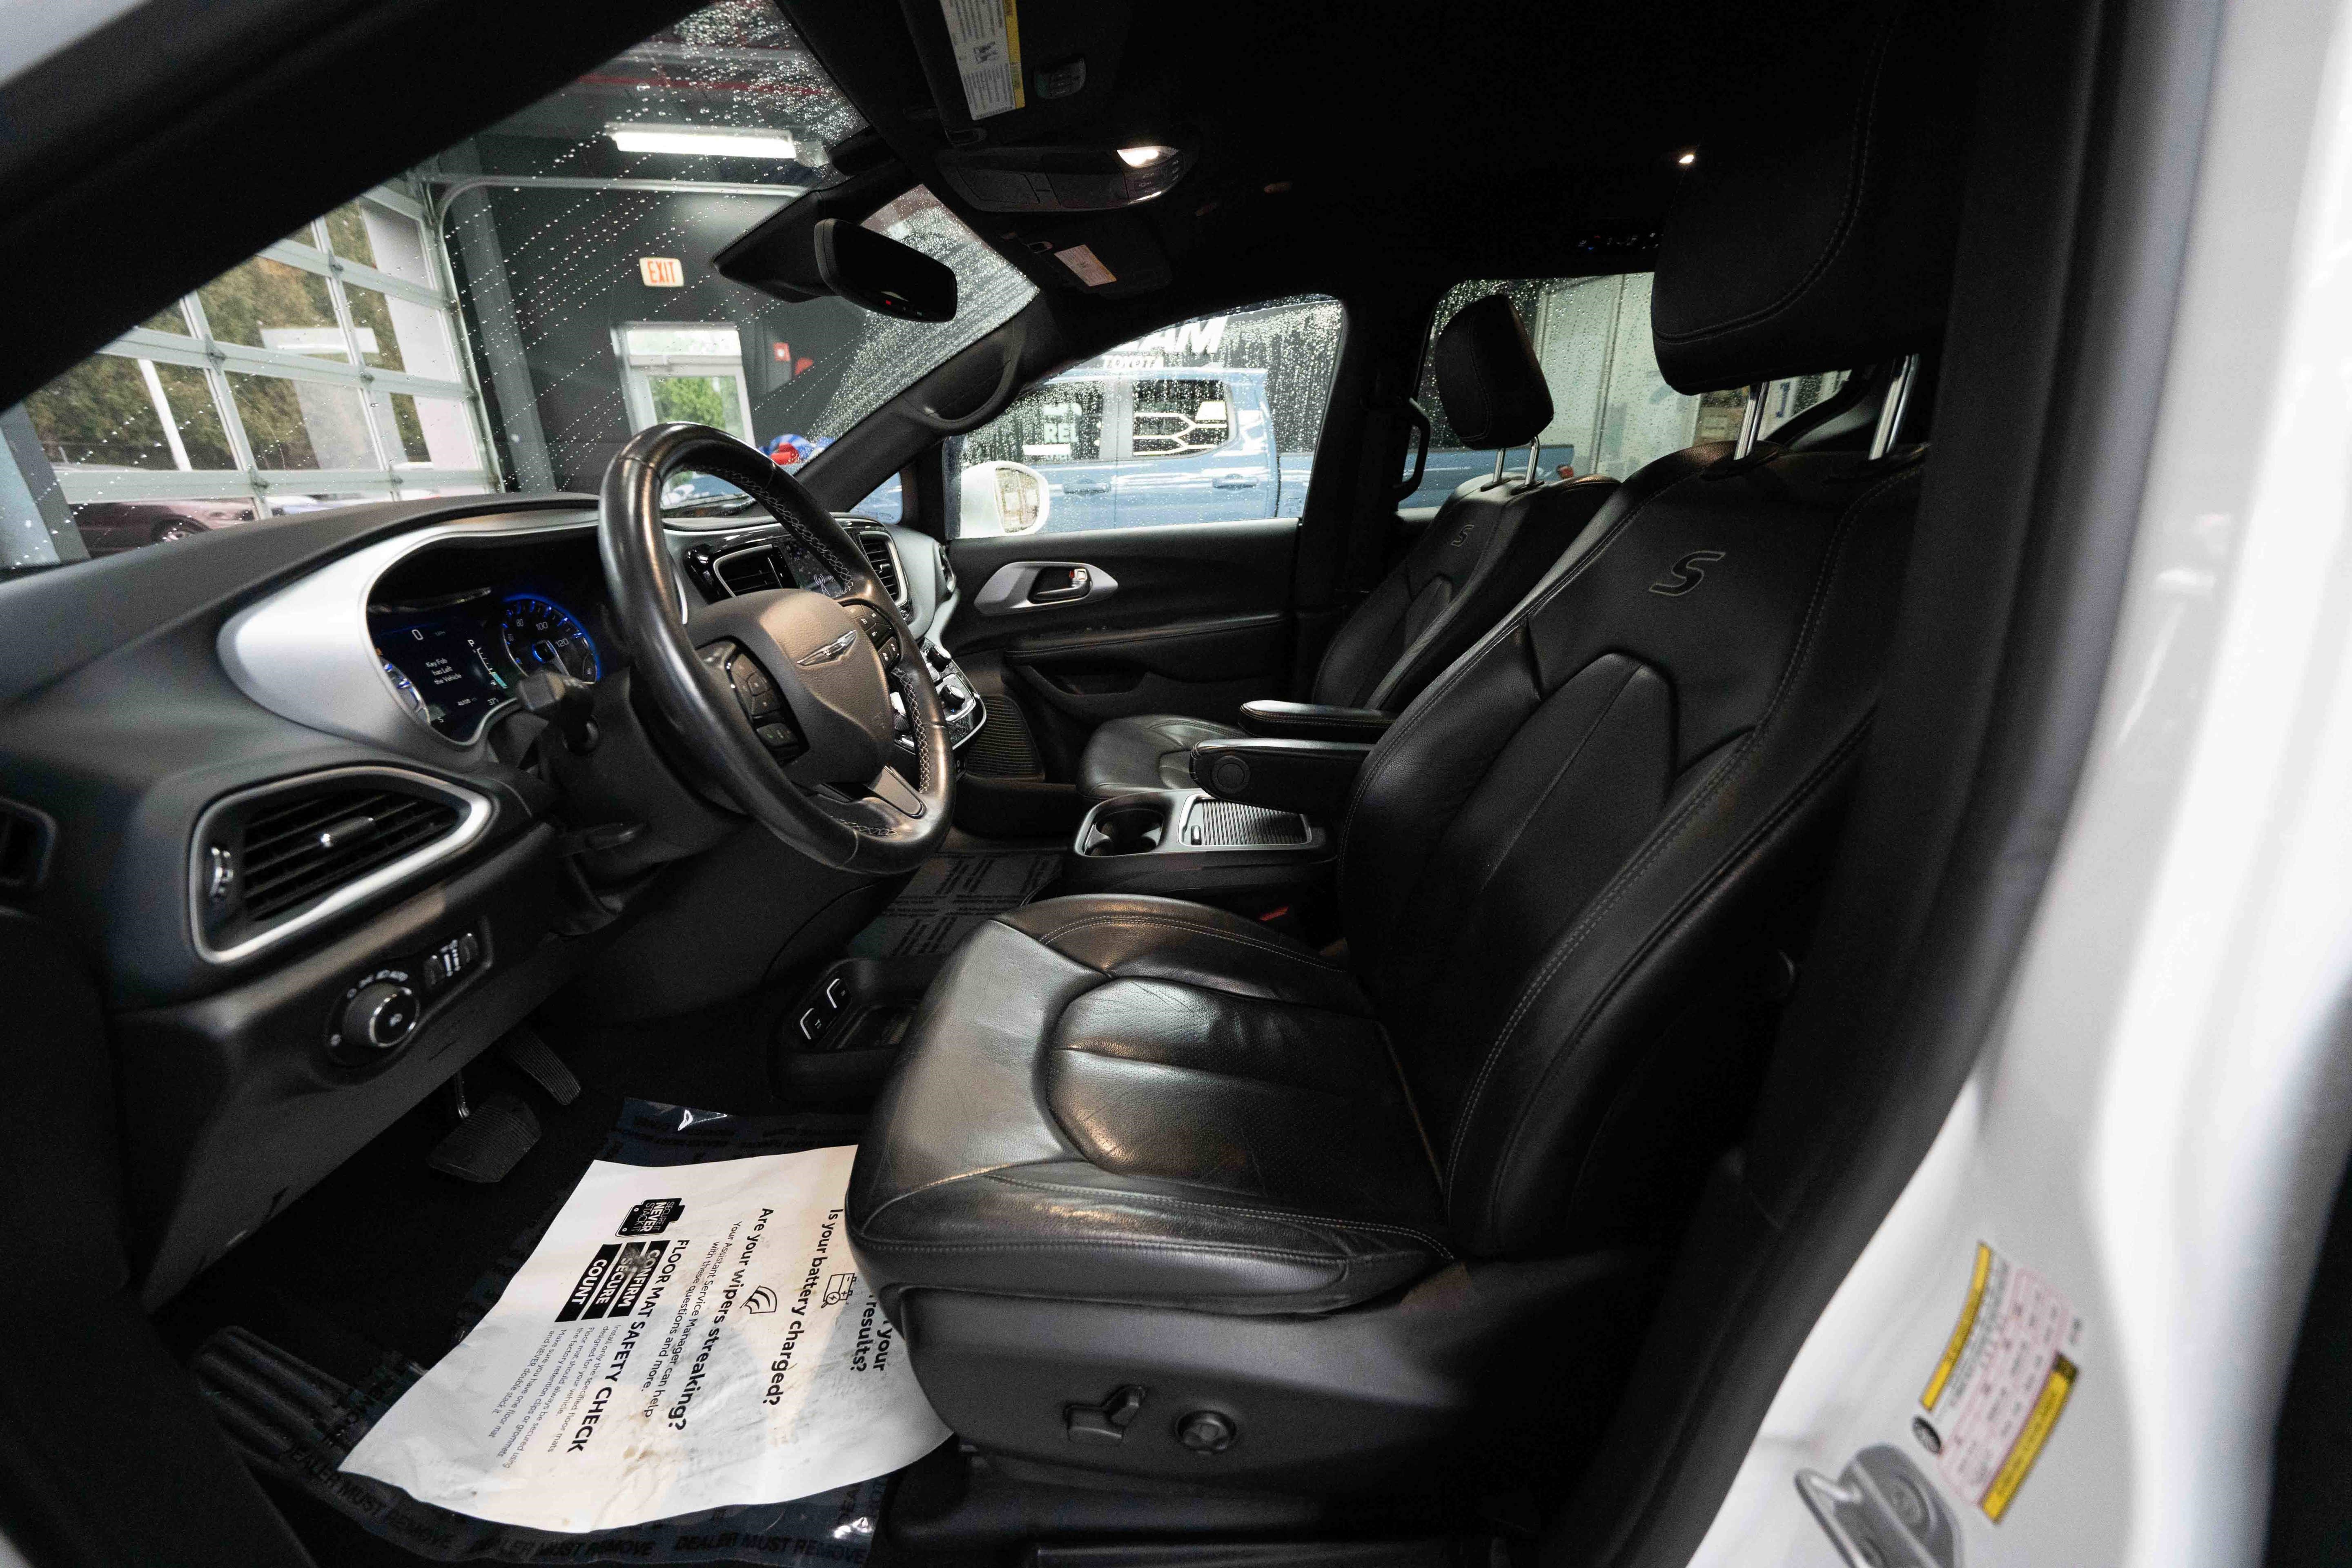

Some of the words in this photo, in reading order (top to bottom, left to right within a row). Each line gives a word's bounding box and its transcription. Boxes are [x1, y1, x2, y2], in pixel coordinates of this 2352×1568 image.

[647, 260, 677, 283] EXIT
[1649, 550, 1726, 597] S
[516, 619, 523, 627] 80
[536, 621, 548, 630] 100
[412, 629, 424, 640] 0
[555, 638, 569, 647] 120
[442, 673, 462, 682] Vehicle
[637, 1203, 655, 1224] STACK
[640, 1202, 666, 1231] NEVER
[653, 1202, 674, 1225] SECURE
[754, 1208, 774, 1231] Are
[829, 1209, 843, 1220] Is
[728, 1221, 742, 1240] Your
[816, 1223, 835, 1253] your
[706, 1242, 719, 1258] with
[739, 1234, 760, 1265] your
[655, 1240, 690, 1284] FLOOR
[707, 1243, 732, 1278] Assistant
[572, 1260, 607, 1304] COUNT
[596, 1258, 633, 1304] SECURE
[618, 1250, 660, 1307] CONFIRM
[693, 1261, 711, 1283] these
[714, 1270, 745, 1323] wipers
[791, 1257, 828, 1316] battery
[638, 1287, 664, 1317] MAT
[692, 1281, 713, 1316] Service
[670, 1285, 695, 1334] questions
[544, 1331, 554, 1343] and
[552, 1330, 567, 1347] Make
[573, 1328, 583, 1339] the
[581, 1327, 595, 1343] Floor
[588, 1326, 609, 1357] designed
[605, 1325, 621, 1344] Install
[670, 1319, 698, 1365] Manager
[850, 1301, 877, 1372] results?
[528, 1345, 547, 1366] NEVER
[542, 1349, 554, 1363] sure
[558, 1341, 577, 1364] factory
[572, 1346, 583, 1359] mat
[596, 1346, 607, 1361] only
[605, 1322, 645, 1382] SAFETY
[659, 1337, 673, 1356] and
[873, 1326, 893, 1371] your
[533, 1365, 544, 1376] you
[559, 1361, 575, 1383] should
[583, 1359, 592, 1368] for
[590, 1363, 600, 1375] the
[763, 1321, 804, 1405] charged?
[511, 1368, 530, 1390] double
[521, 1379, 537, 1394] have
[539, 1366, 561, 1396] retention
[574, 1371, 584, 1386] your
[641, 1361, 662, 1391] more.
[658, 1368, 672, 1386] can
[668, 1328, 719, 1430] streaking?
[497, 1392, 512, 1408] stack
[511, 1396, 523, 1408] one
[543, 1386, 560, 1409] always
[571, 1378, 592, 1410] specified
[644, 1390, 665, 1417] help
[500, 1410, 515, 1424] floor
[528, 1399, 541, 1414] clips
[537, 1412, 548, 1421] be
[561, 1413, 575, 1430] floor
[567, 1387, 612, 1452] CHECK
[488, 1425, 501, 1437] mat
[517, 1423, 539, 1451] secured
[548, 1434, 562, 1452] mats
[501, 1452, 520, 1469] using
[676, 1532, 739, 1551] DEALER
[744, 1535, 790, 1551] MUST
